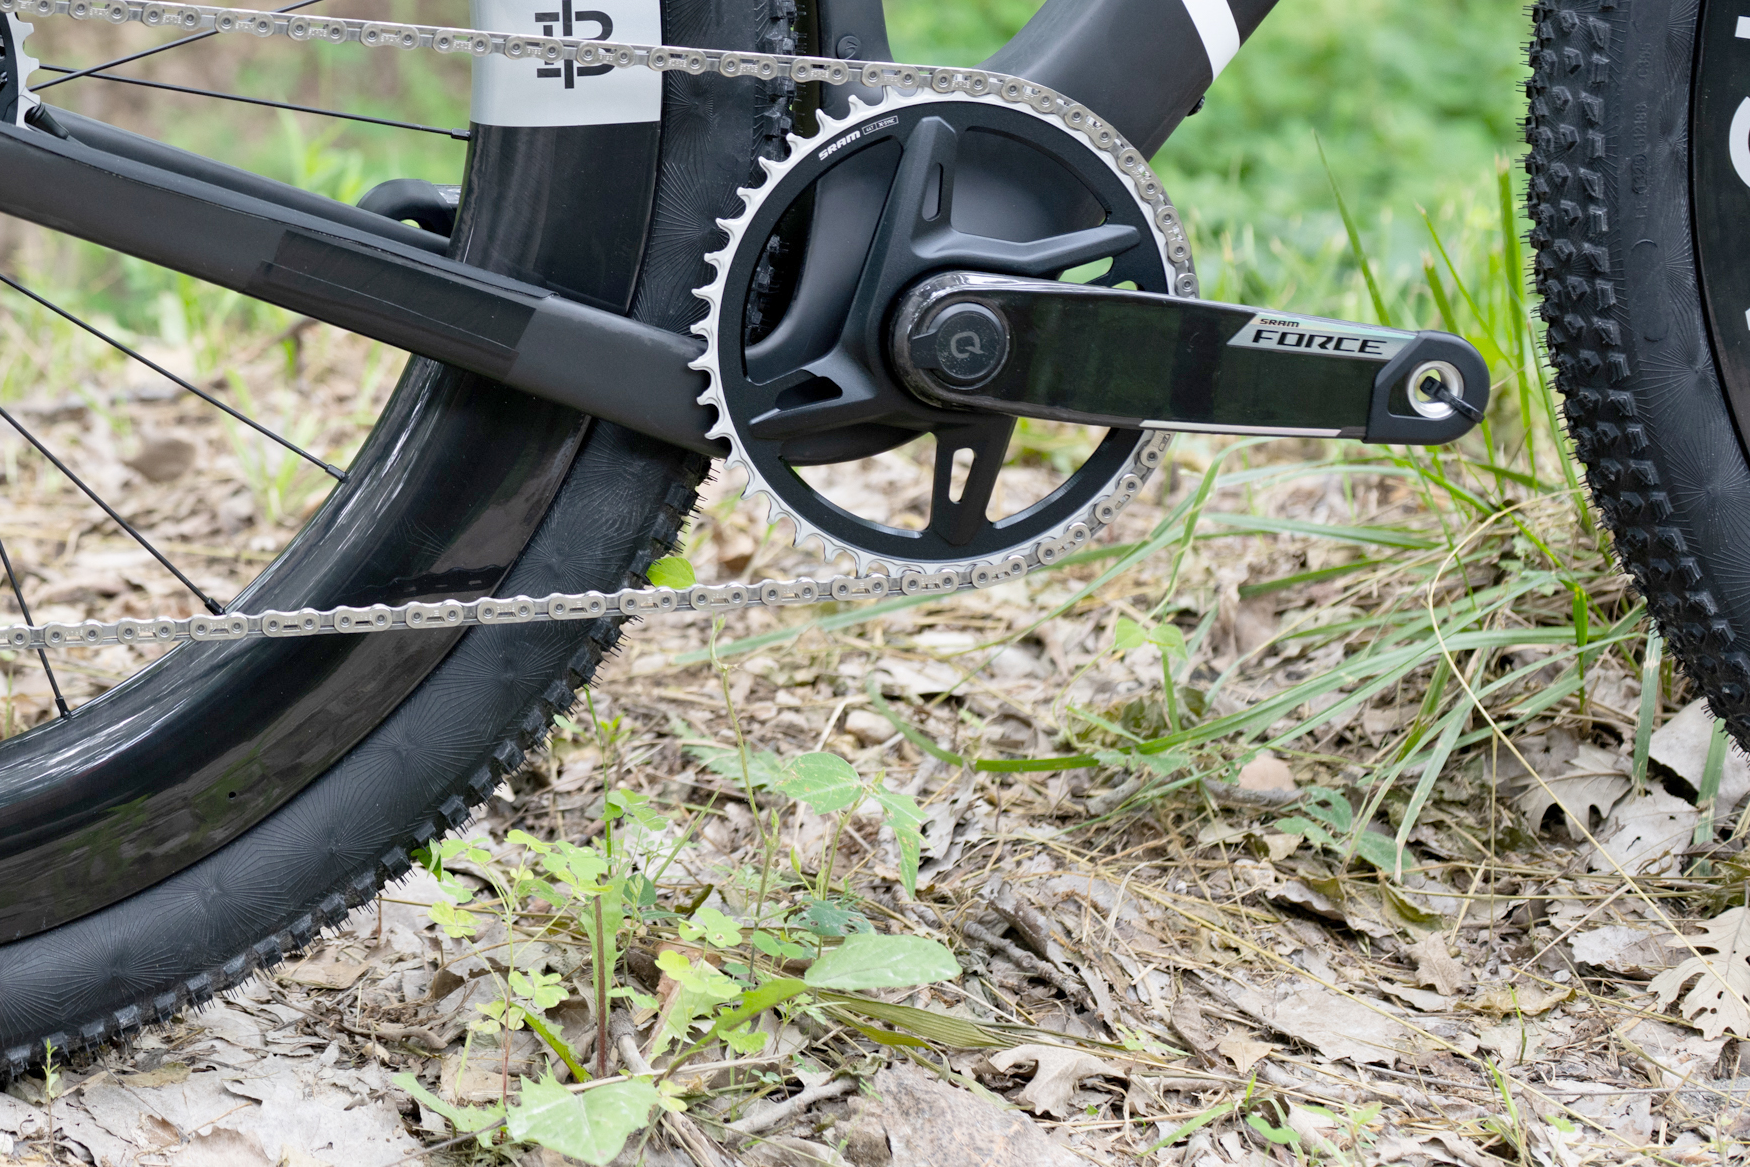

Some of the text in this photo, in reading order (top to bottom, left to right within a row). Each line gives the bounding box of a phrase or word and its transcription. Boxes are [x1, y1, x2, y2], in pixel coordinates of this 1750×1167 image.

[818, 130, 861, 161] SRAM
[1259, 318, 1300, 328] SRAM
[1251, 329, 1388, 355] FORCE
